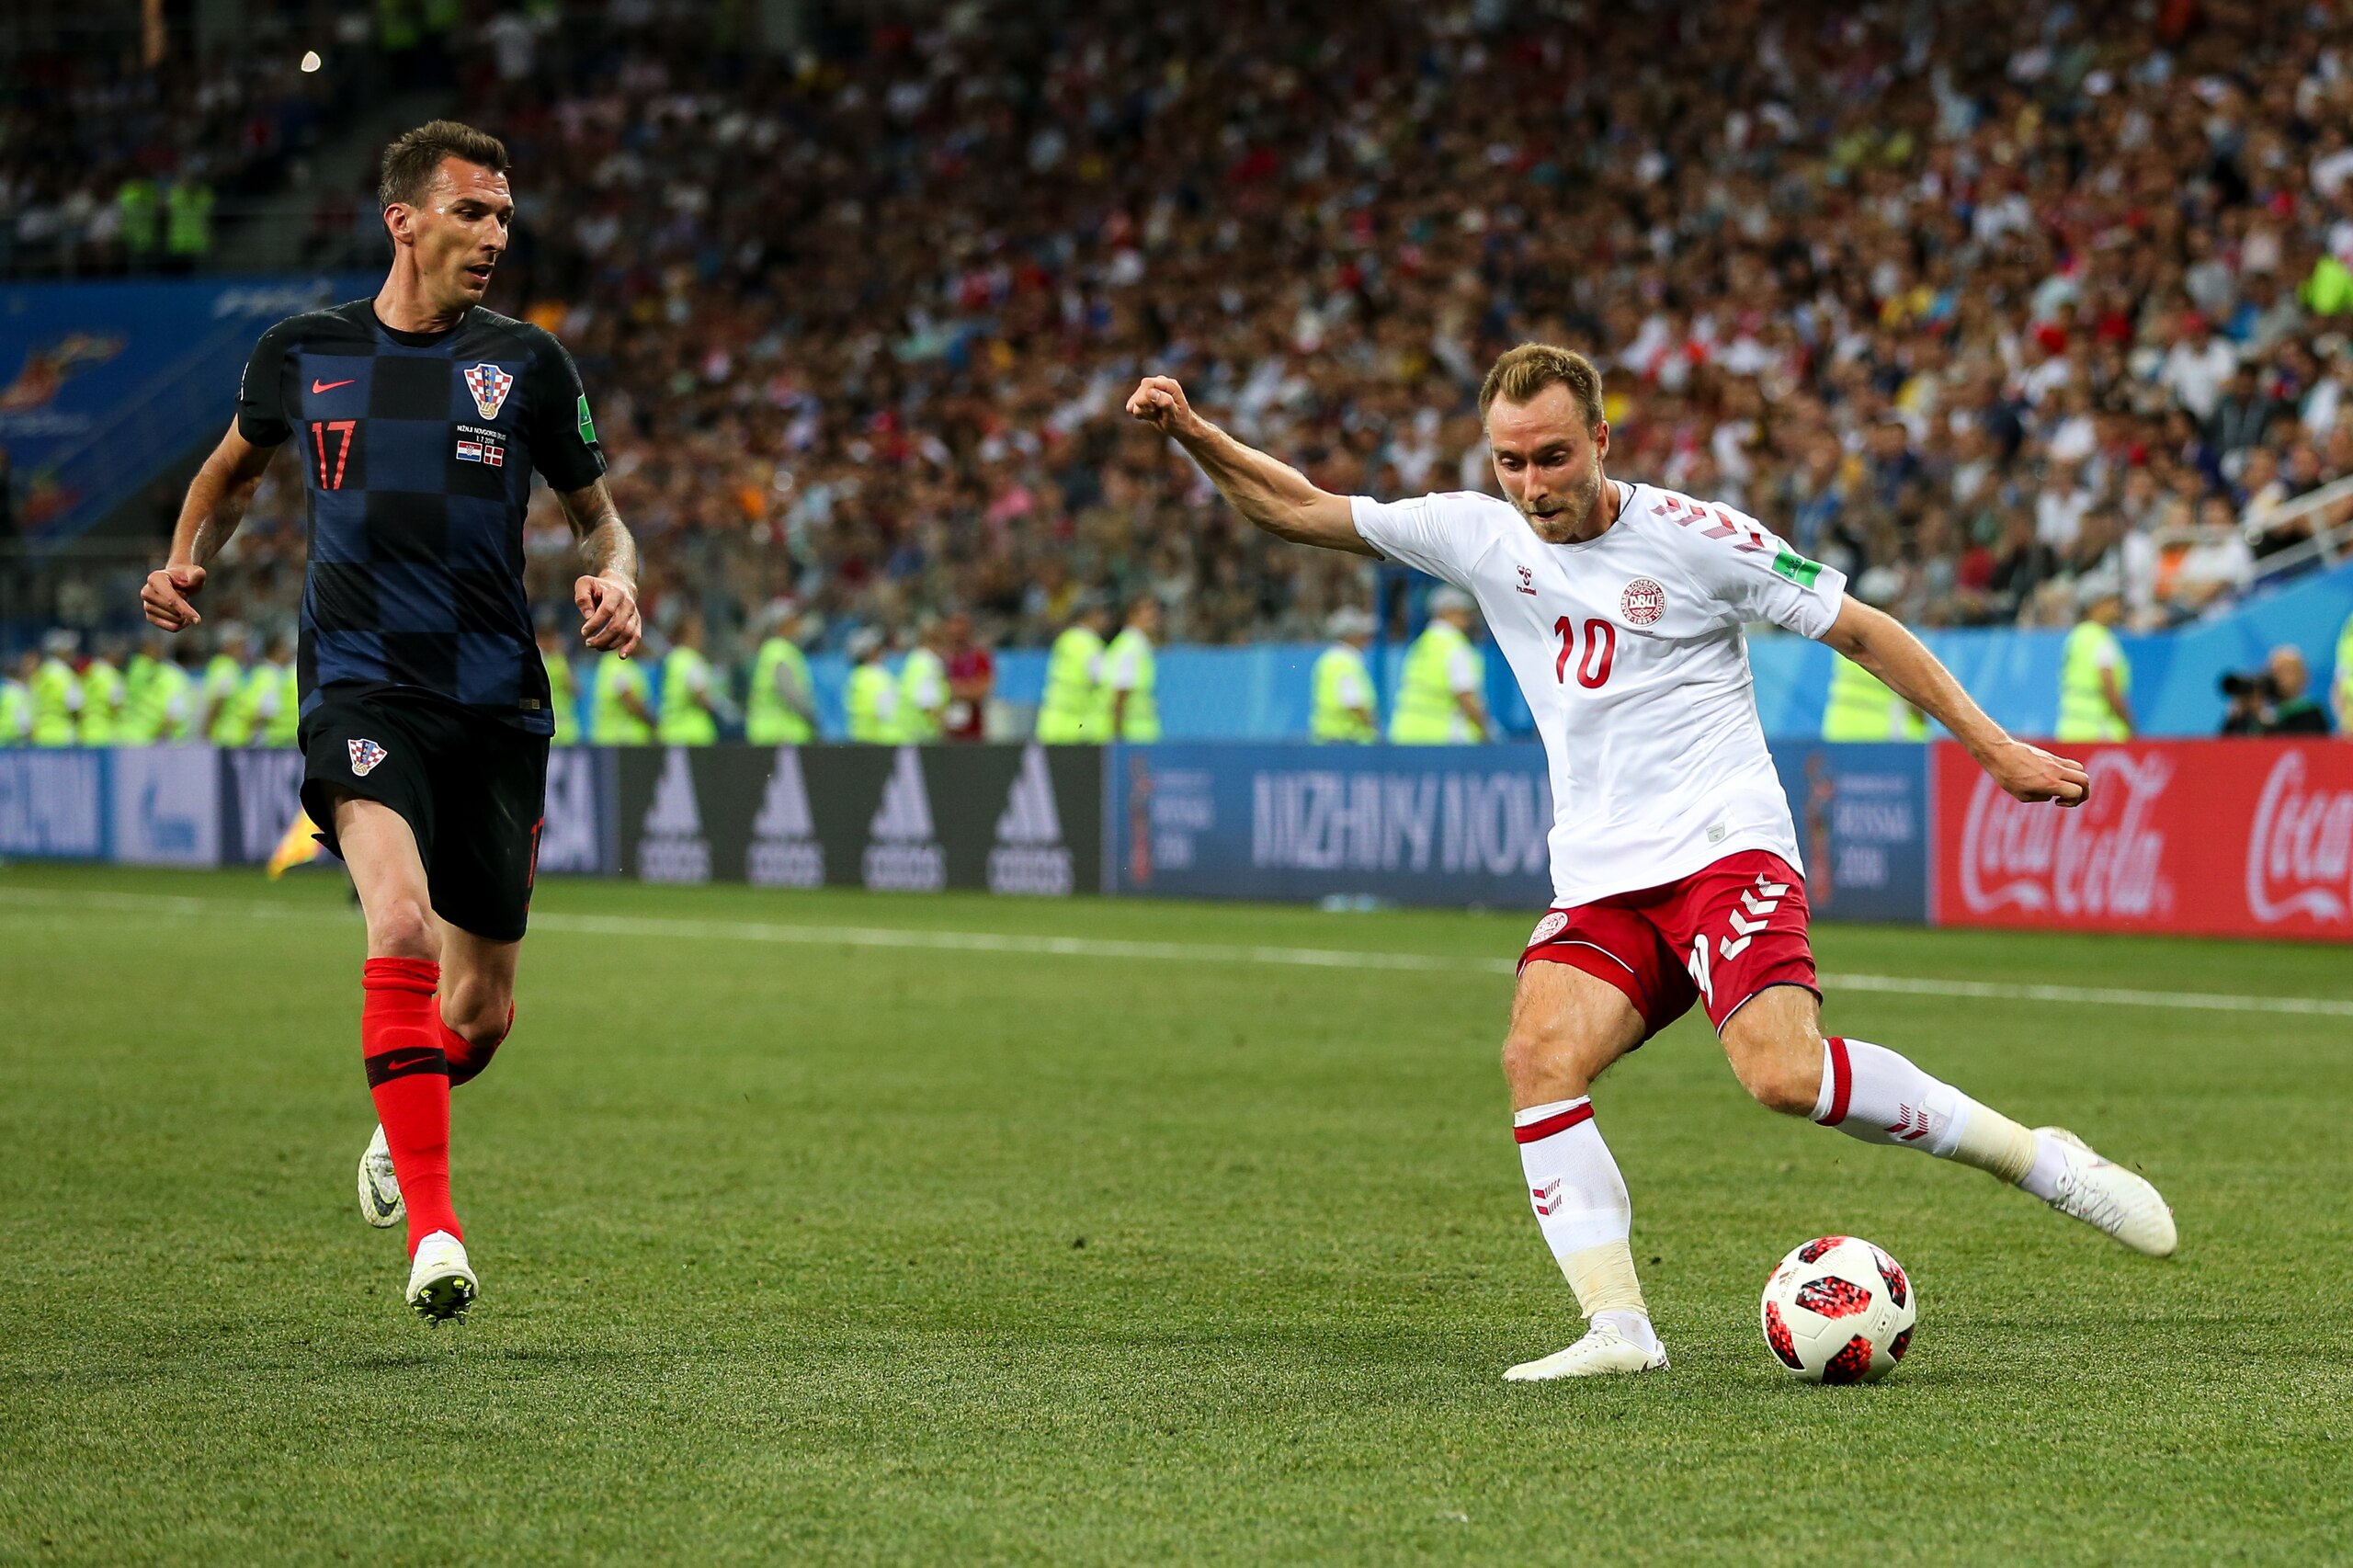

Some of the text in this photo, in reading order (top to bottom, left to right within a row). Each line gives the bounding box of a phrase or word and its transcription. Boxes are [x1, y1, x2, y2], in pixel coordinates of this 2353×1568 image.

[312, 420, 357, 490] 17
[1628, 594, 1657, 608] DBU
[1553, 615, 1616, 689] 10
[1252, 769, 1439, 874] NIZHNY
